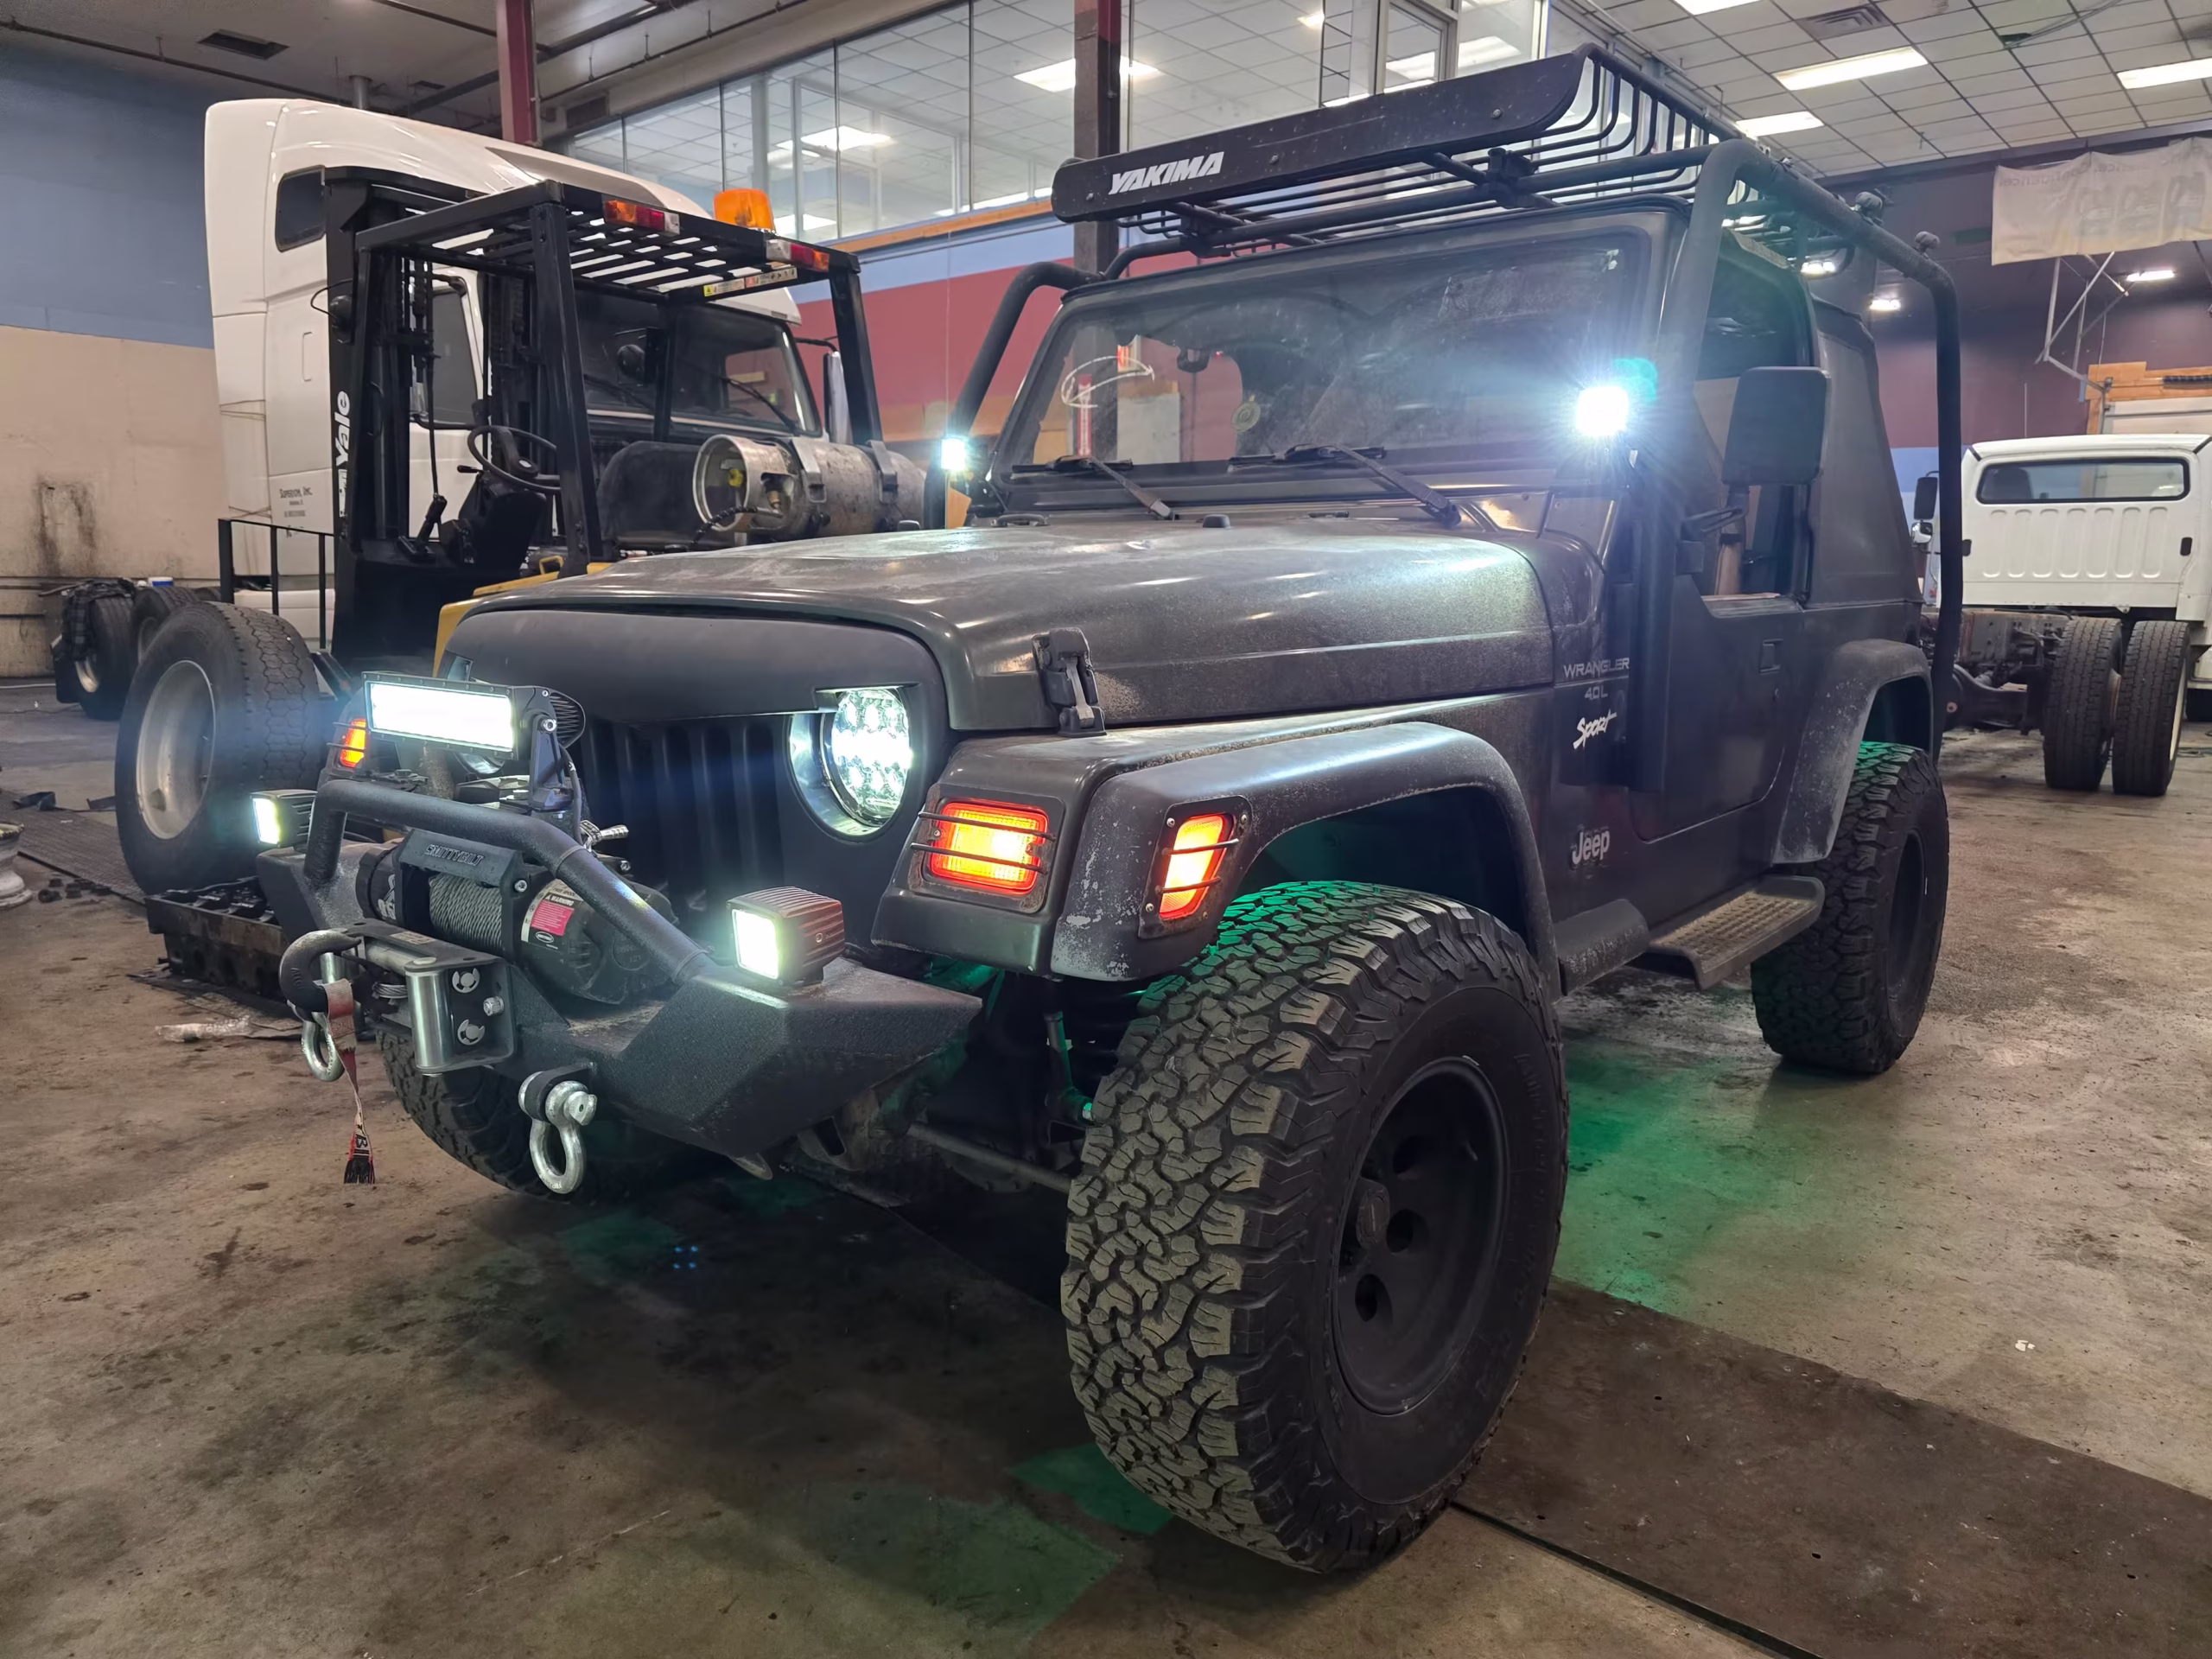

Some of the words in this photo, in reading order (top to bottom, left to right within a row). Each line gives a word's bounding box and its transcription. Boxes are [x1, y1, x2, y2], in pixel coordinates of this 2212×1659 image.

[1108, 151, 1224, 195] YAKIMA
[334, 391, 351, 467] Yale
[1563, 657, 1630, 678] WRANGLER
[1573, 709, 1618, 750] Sport
[1572, 830, 1611, 865] Jeep
[550, 894, 575, 906] WARNING
